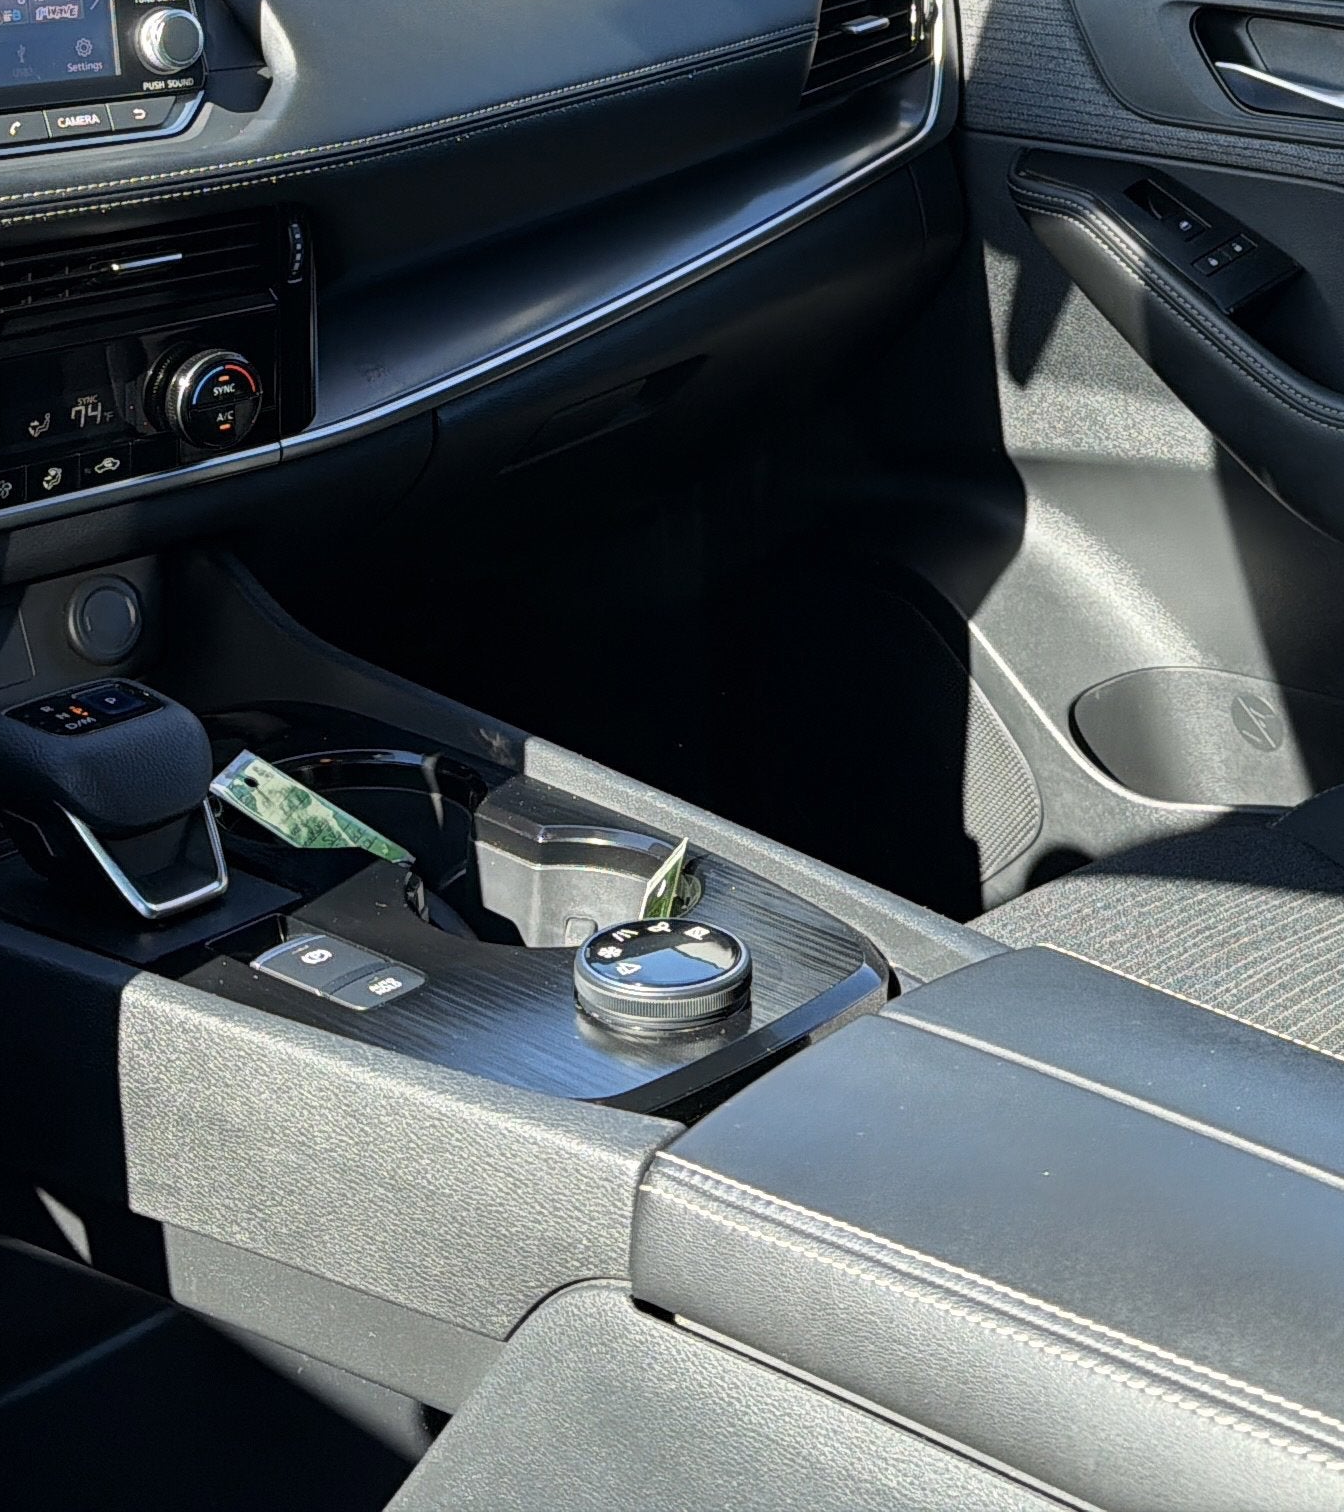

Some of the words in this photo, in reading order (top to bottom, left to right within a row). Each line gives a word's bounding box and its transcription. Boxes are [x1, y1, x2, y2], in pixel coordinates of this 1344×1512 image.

[67, 60, 103, 74] Settings
[142, 80, 166, 91] PUSH
[167, 77, 195, 89] SOUND
[57, 113, 101, 128] CAMERA
[213, 383, 235, 396] SYNC
[77, 394, 98, 406] SYNC
[216, 411, 234, 422] A/C
